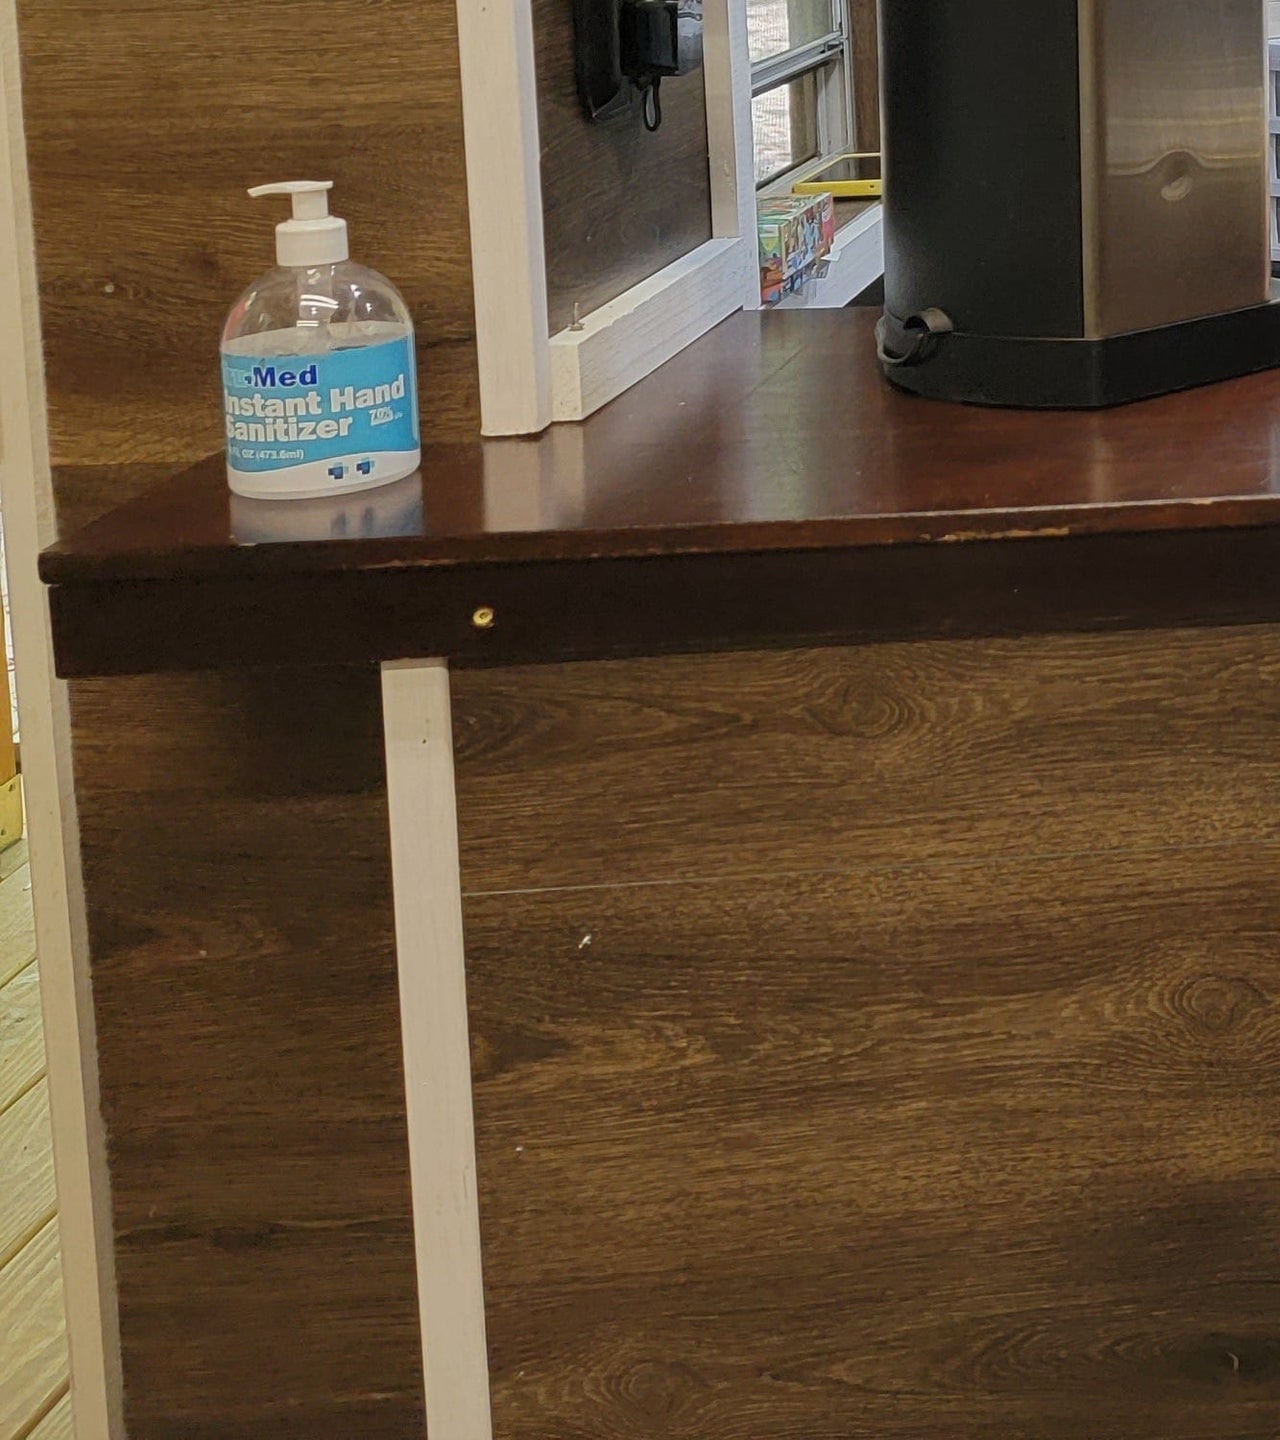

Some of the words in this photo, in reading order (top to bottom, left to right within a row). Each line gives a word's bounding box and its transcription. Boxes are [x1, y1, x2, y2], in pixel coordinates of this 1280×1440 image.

[225, 389, 322, 418] Instant
[329, 373, 406, 413] Hand
[226, 414, 353, 443] Sanitizer
